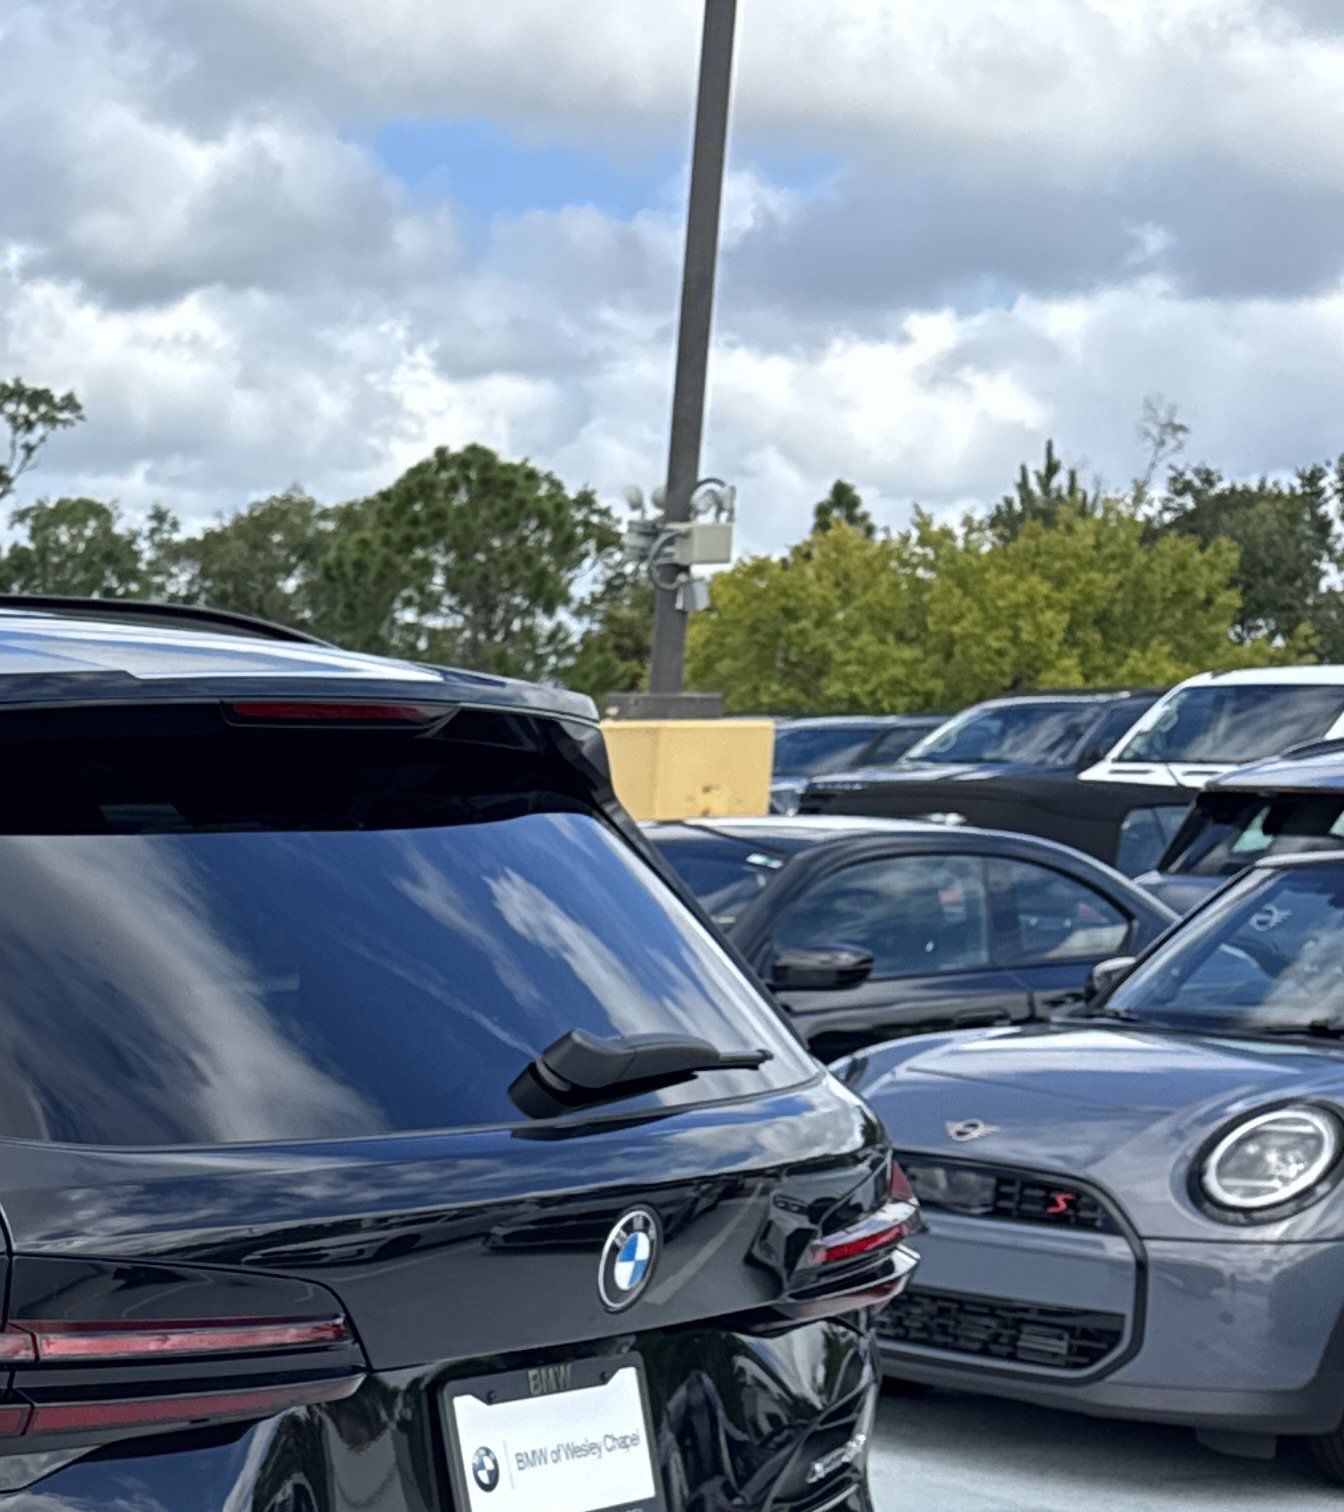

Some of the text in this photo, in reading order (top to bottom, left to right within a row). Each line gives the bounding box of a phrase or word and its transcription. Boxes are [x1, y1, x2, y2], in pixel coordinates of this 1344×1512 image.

[528, 1363, 571, 1395] BMW
[515, 1447, 548, 1471] BMW
[550, 1443, 564, 1464] of
[563, 1438, 603, 1460] Wesley
[603, 1428, 641, 1453] Chapel
